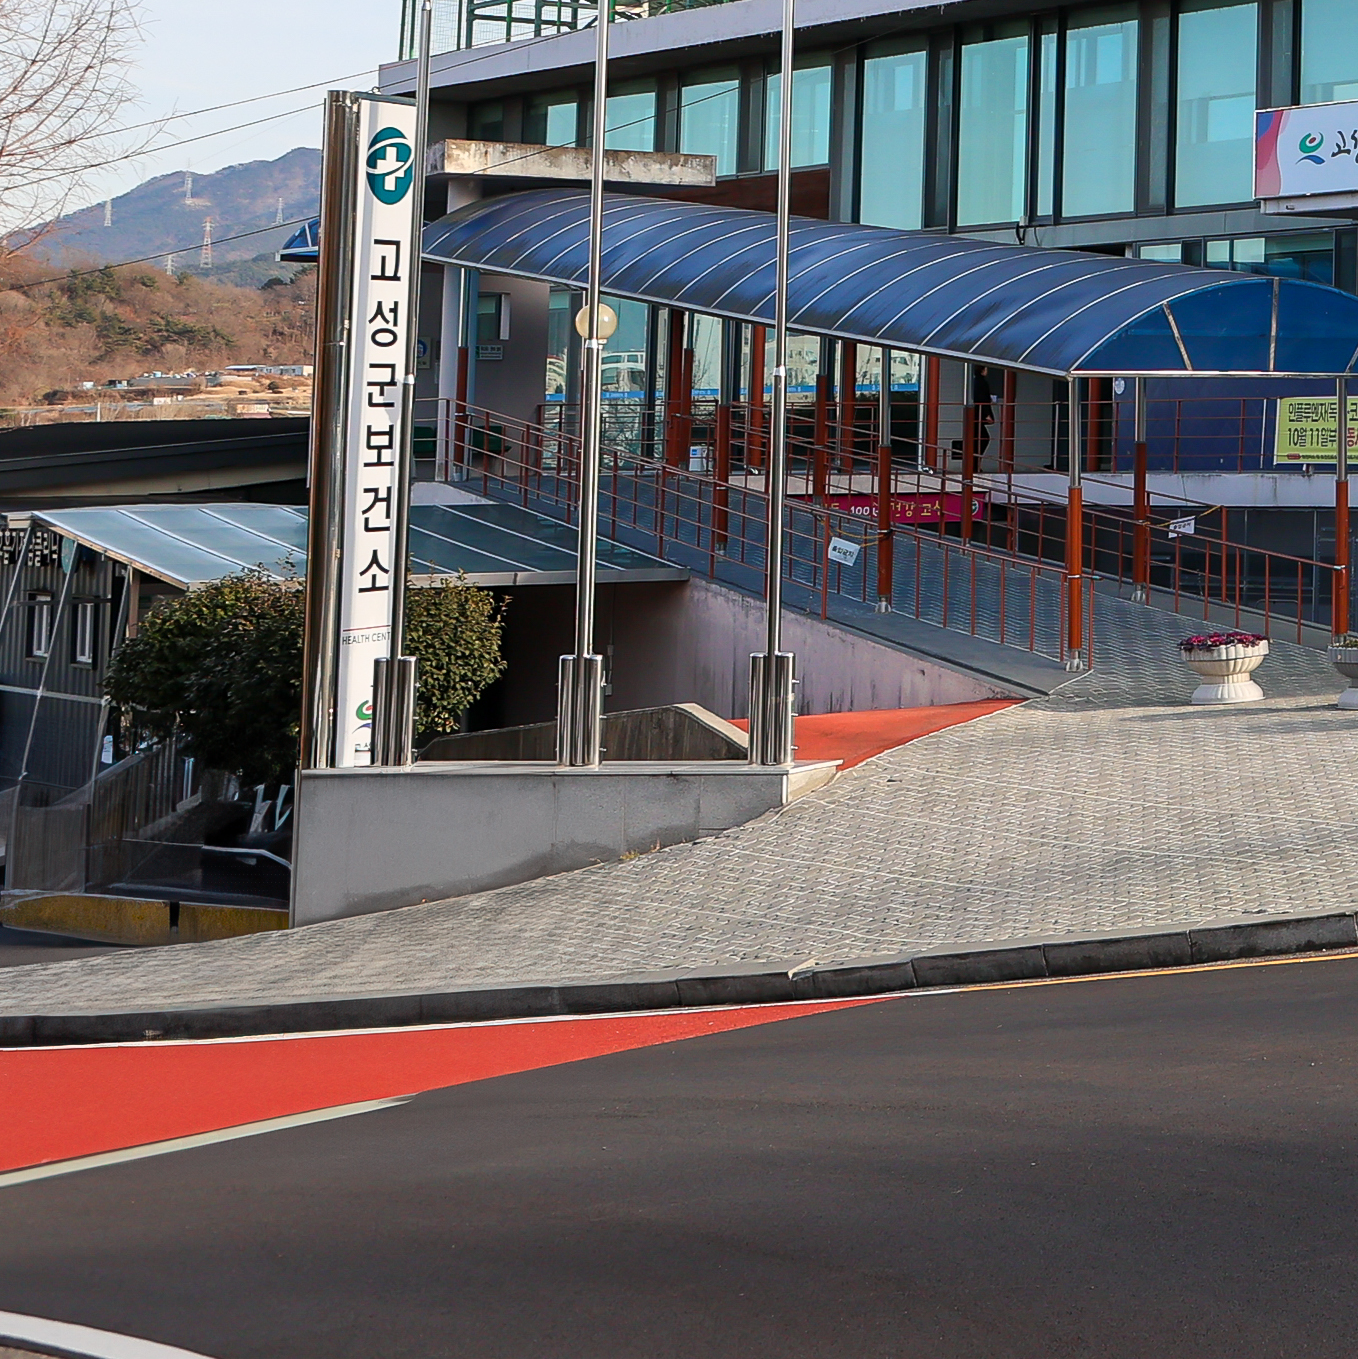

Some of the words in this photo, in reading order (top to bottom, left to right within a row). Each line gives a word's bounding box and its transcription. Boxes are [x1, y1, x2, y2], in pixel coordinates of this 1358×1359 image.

[357, 237, 402, 594] 고성군보건소
[1287, 427, 1307, 447] 10월
[1309, 427, 1337, 447] 11일부
[342, 634, 370, 645] HEALTH
[371, 631, 391, 642] CENT
